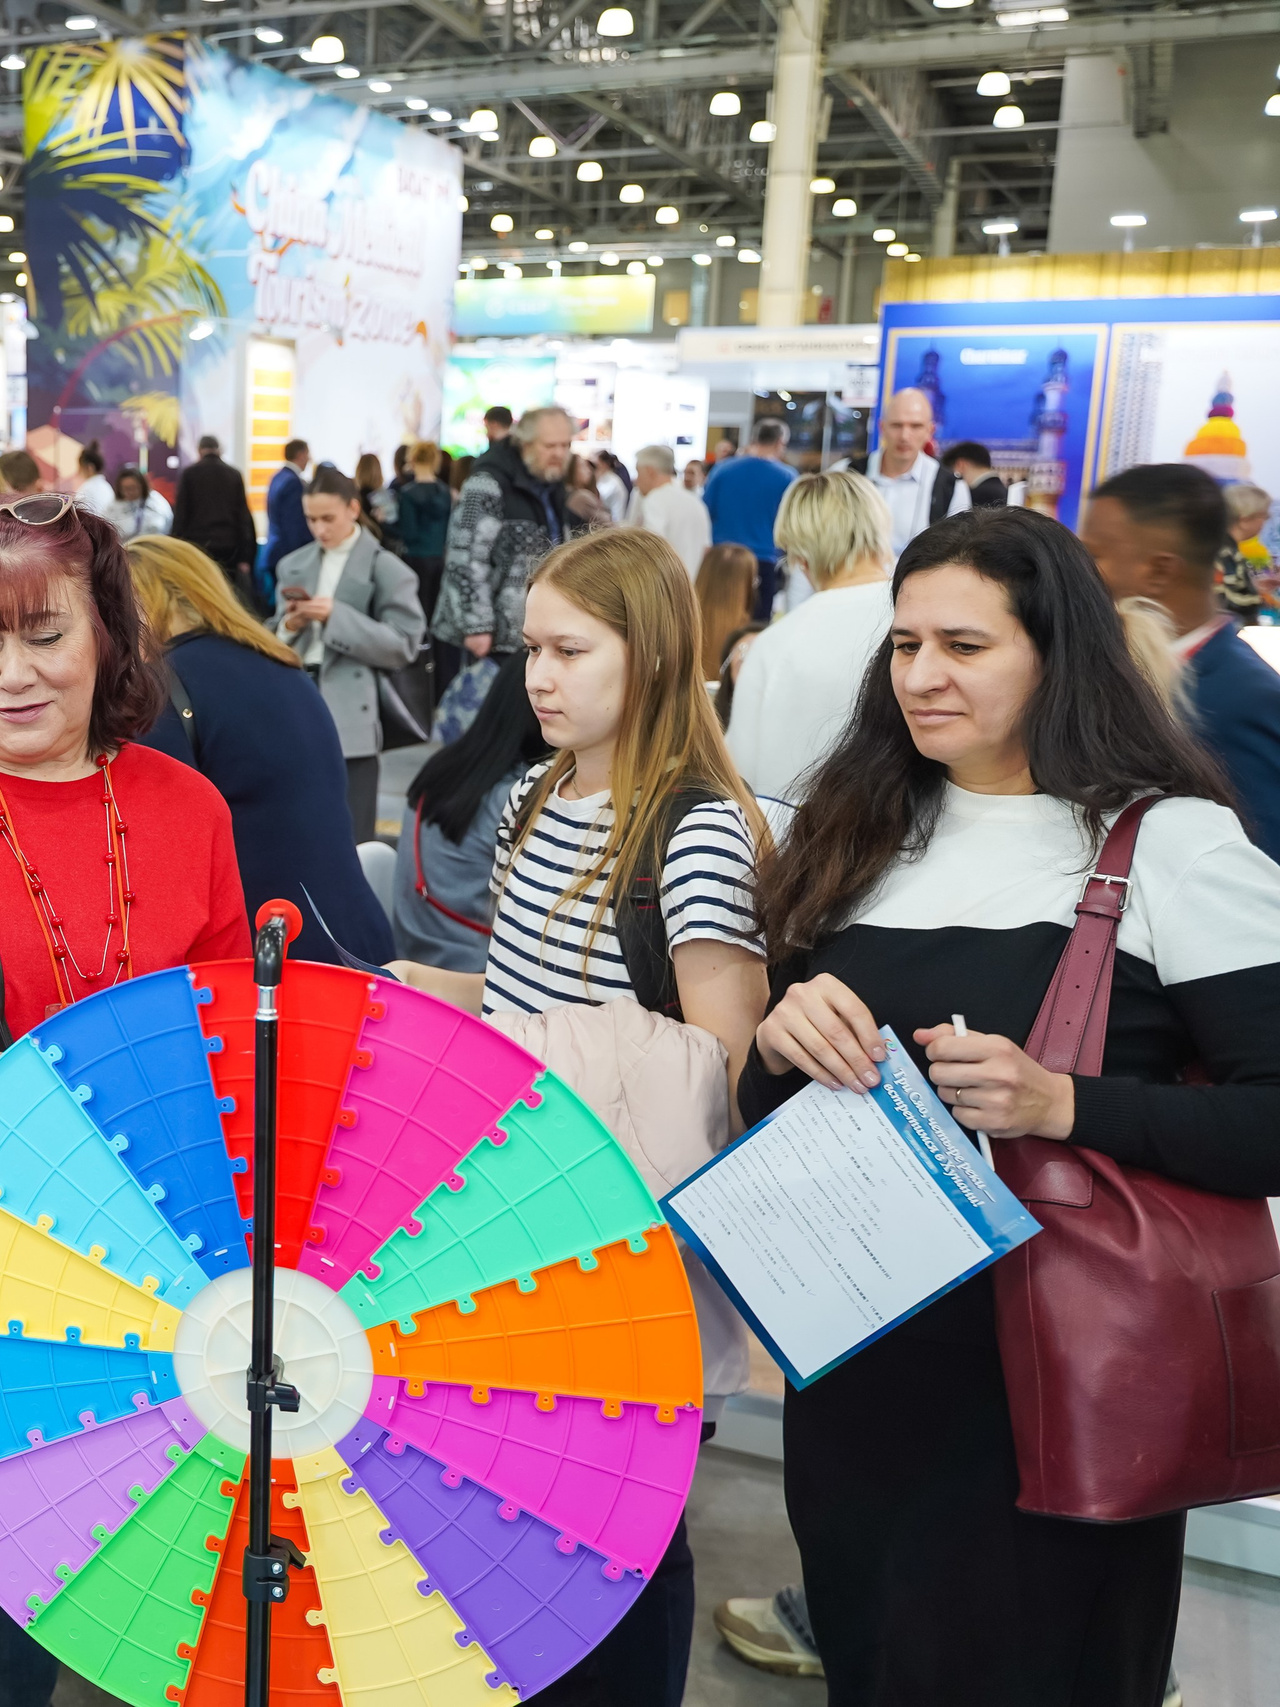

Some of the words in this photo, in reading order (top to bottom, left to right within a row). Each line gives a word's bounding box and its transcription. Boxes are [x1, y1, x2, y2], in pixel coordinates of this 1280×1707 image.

[883, 1083, 940, 1154] встретимся
[892, 1067, 913, 1094] Три
[909, 1090, 929, 1119] Сяо,
[928, 1116, 966, 1163] четыре
[956, 1158, 987, 1190] реки
[934, 1152, 946, 1162] в
[939, 1157, 986, 1208] Хунани!
